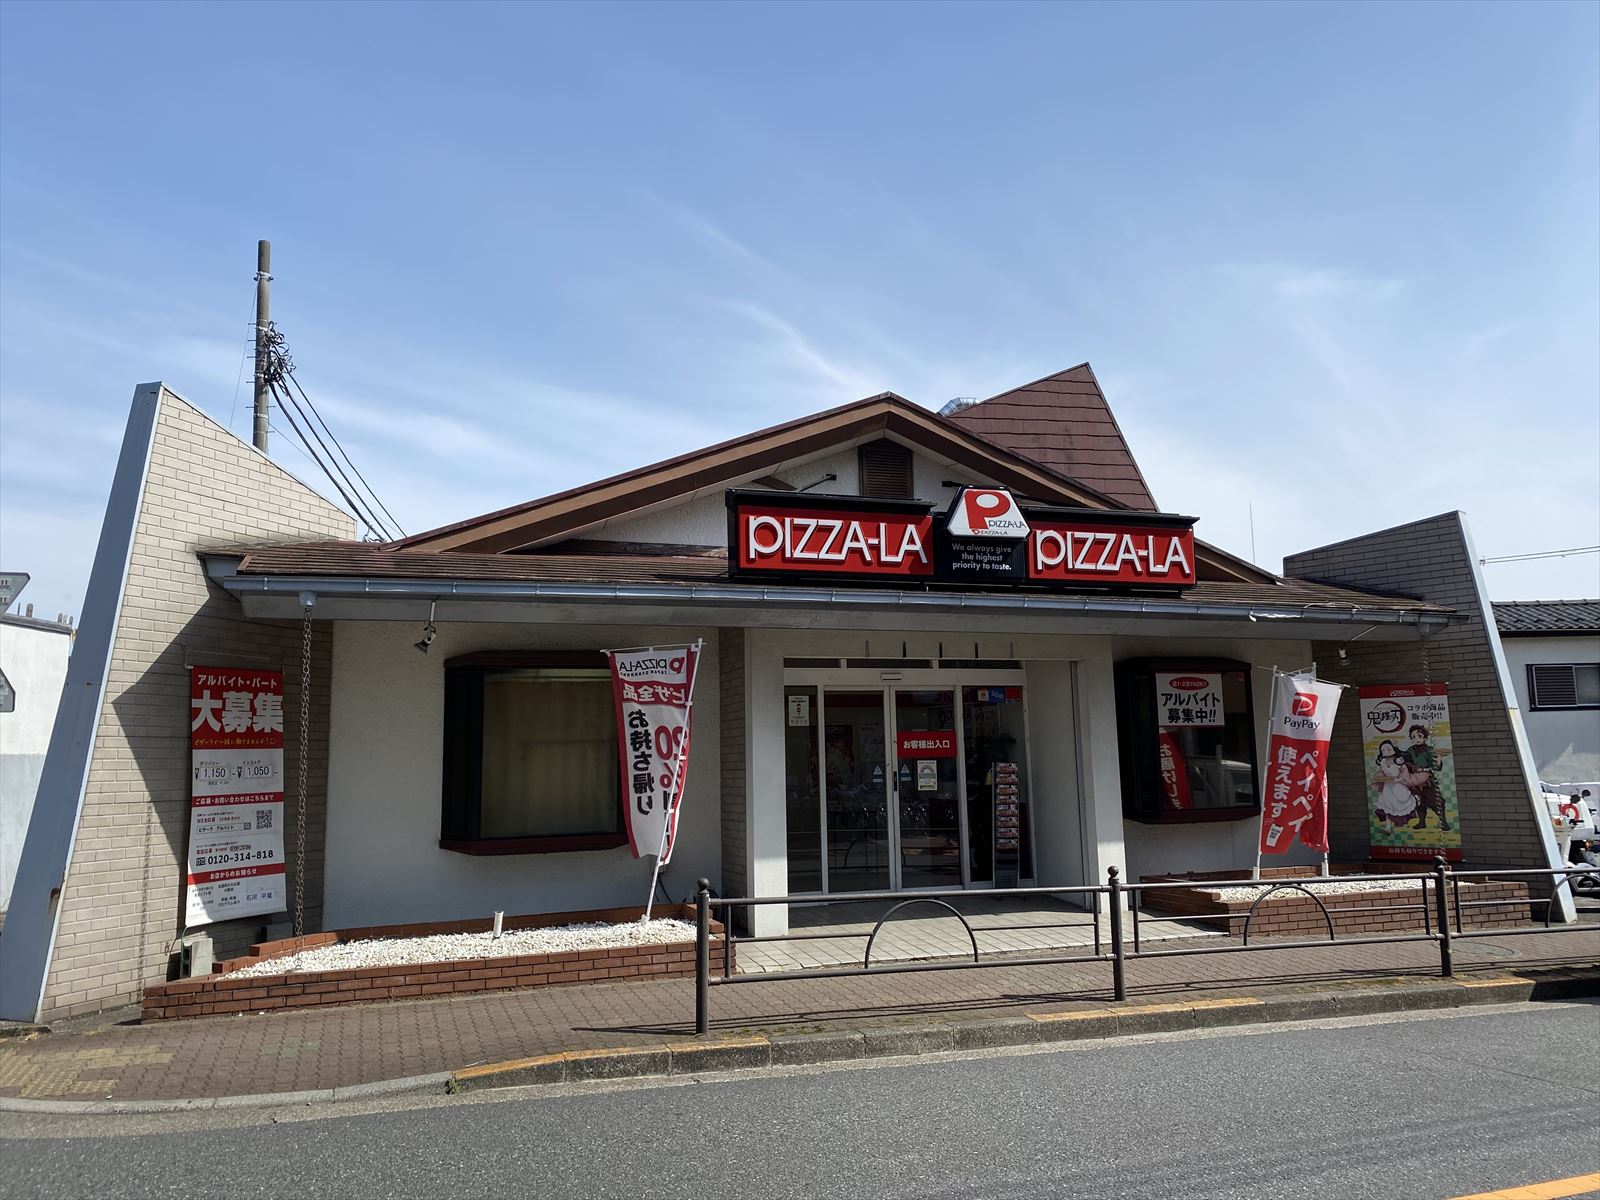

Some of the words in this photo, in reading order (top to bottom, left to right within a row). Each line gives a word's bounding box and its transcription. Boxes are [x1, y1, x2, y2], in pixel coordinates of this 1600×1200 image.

[988, 519, 1027, 529] PIZZA-LA
[748, 515, 929, 564] PIZZA-LA
[952, 543, 965, 551] We
[967, 544, 994, 553] always
[996, 545, 1012, 554] give
[1035, 530, 1192, 576] PIZZA-LA
[961, 552, 974, 560] the
[975, 553, 1003, 562] highest
[952, 561, 981, 570] priority
[197, 674, 277, 689] アルバイト・パート
[1161, 692, 1221, 708] アルバイト
[191, 689, 284, 733] 大募集
[1167, 708, 1217, 724] 募集中!!
[1283, 716, 1321, 731] PayPay
[903, 739, 951, 750] お客様出入口
[1271, 745, 1298, 818] 使えます
[1288, 750, 1319, 832] ペイペイ
[207, 850, 274, 865] 0120-314-818
